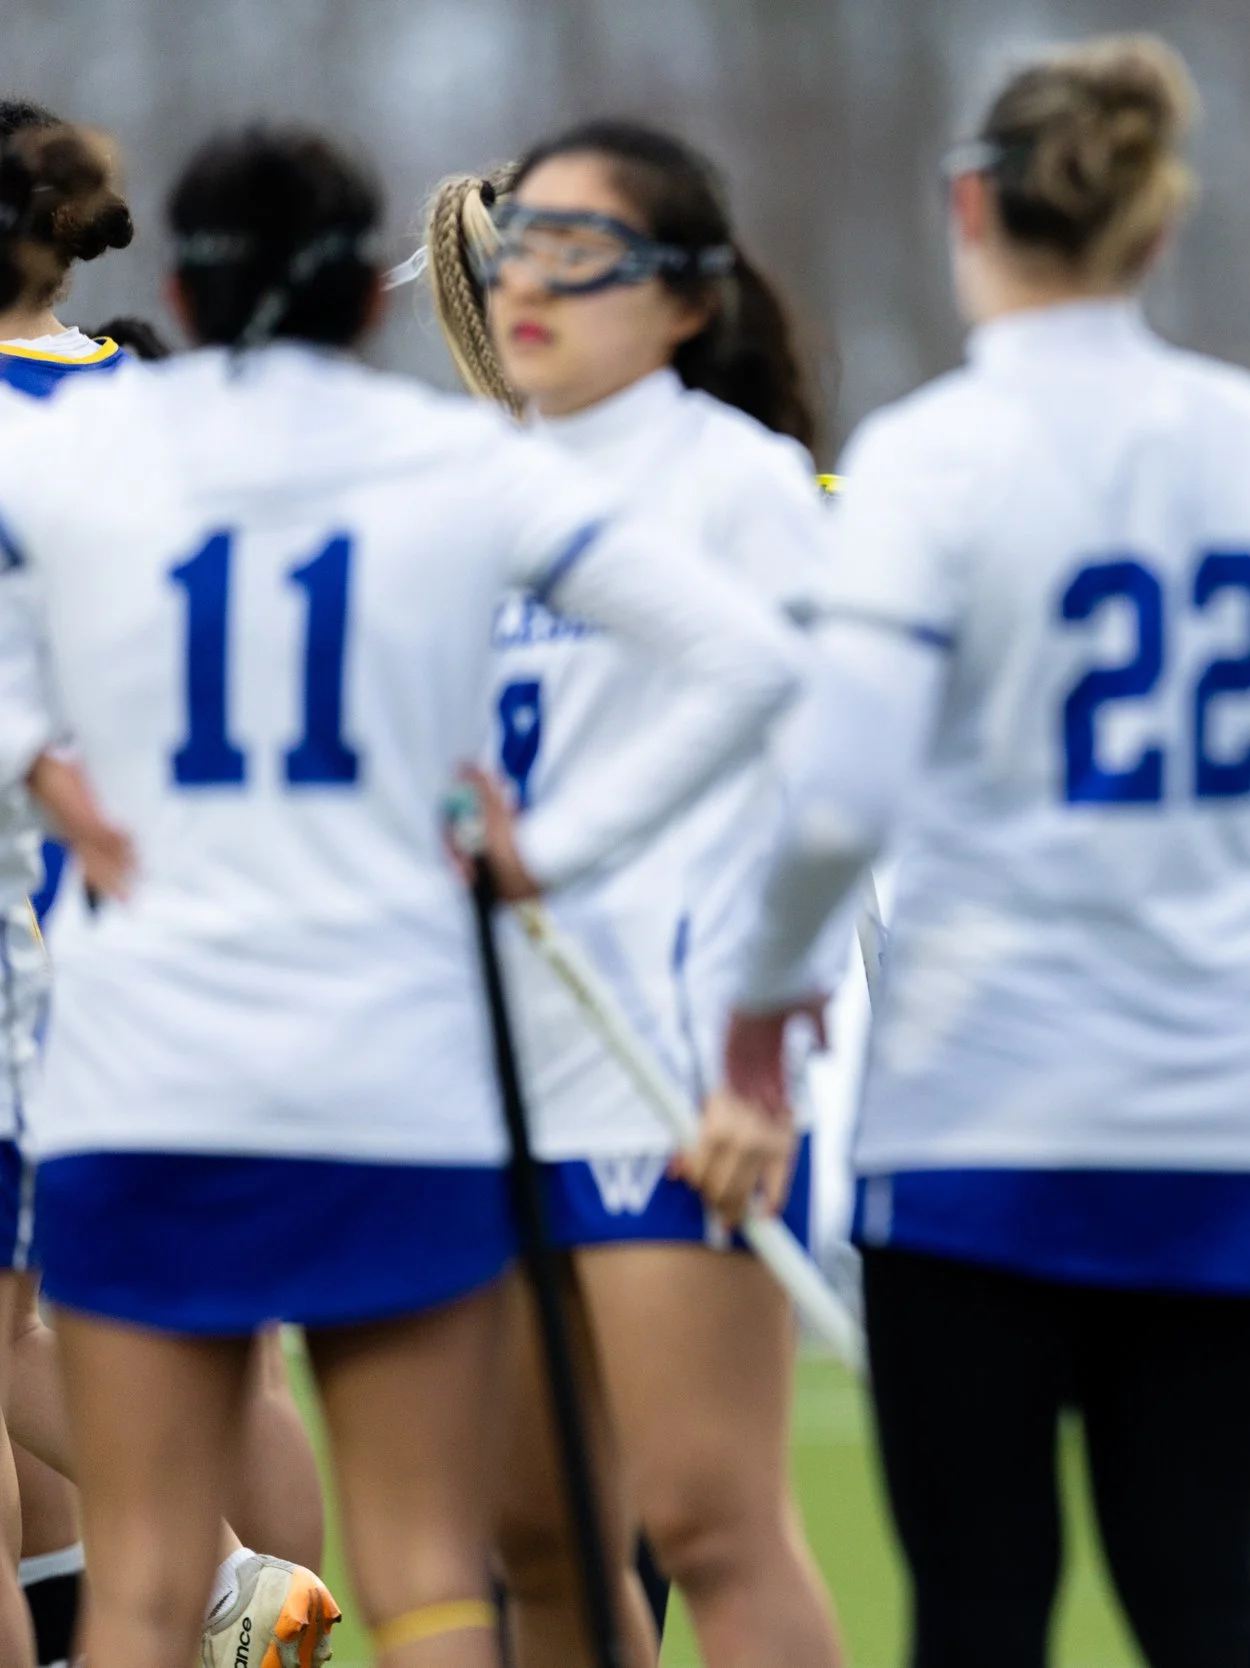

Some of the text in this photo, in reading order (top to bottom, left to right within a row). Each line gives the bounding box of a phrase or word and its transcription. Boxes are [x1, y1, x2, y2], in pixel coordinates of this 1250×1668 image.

[167, 527, 366, 792] 11
[585, 1153, 665, 1216] W
[234, 1616, 252, 1668] ance
